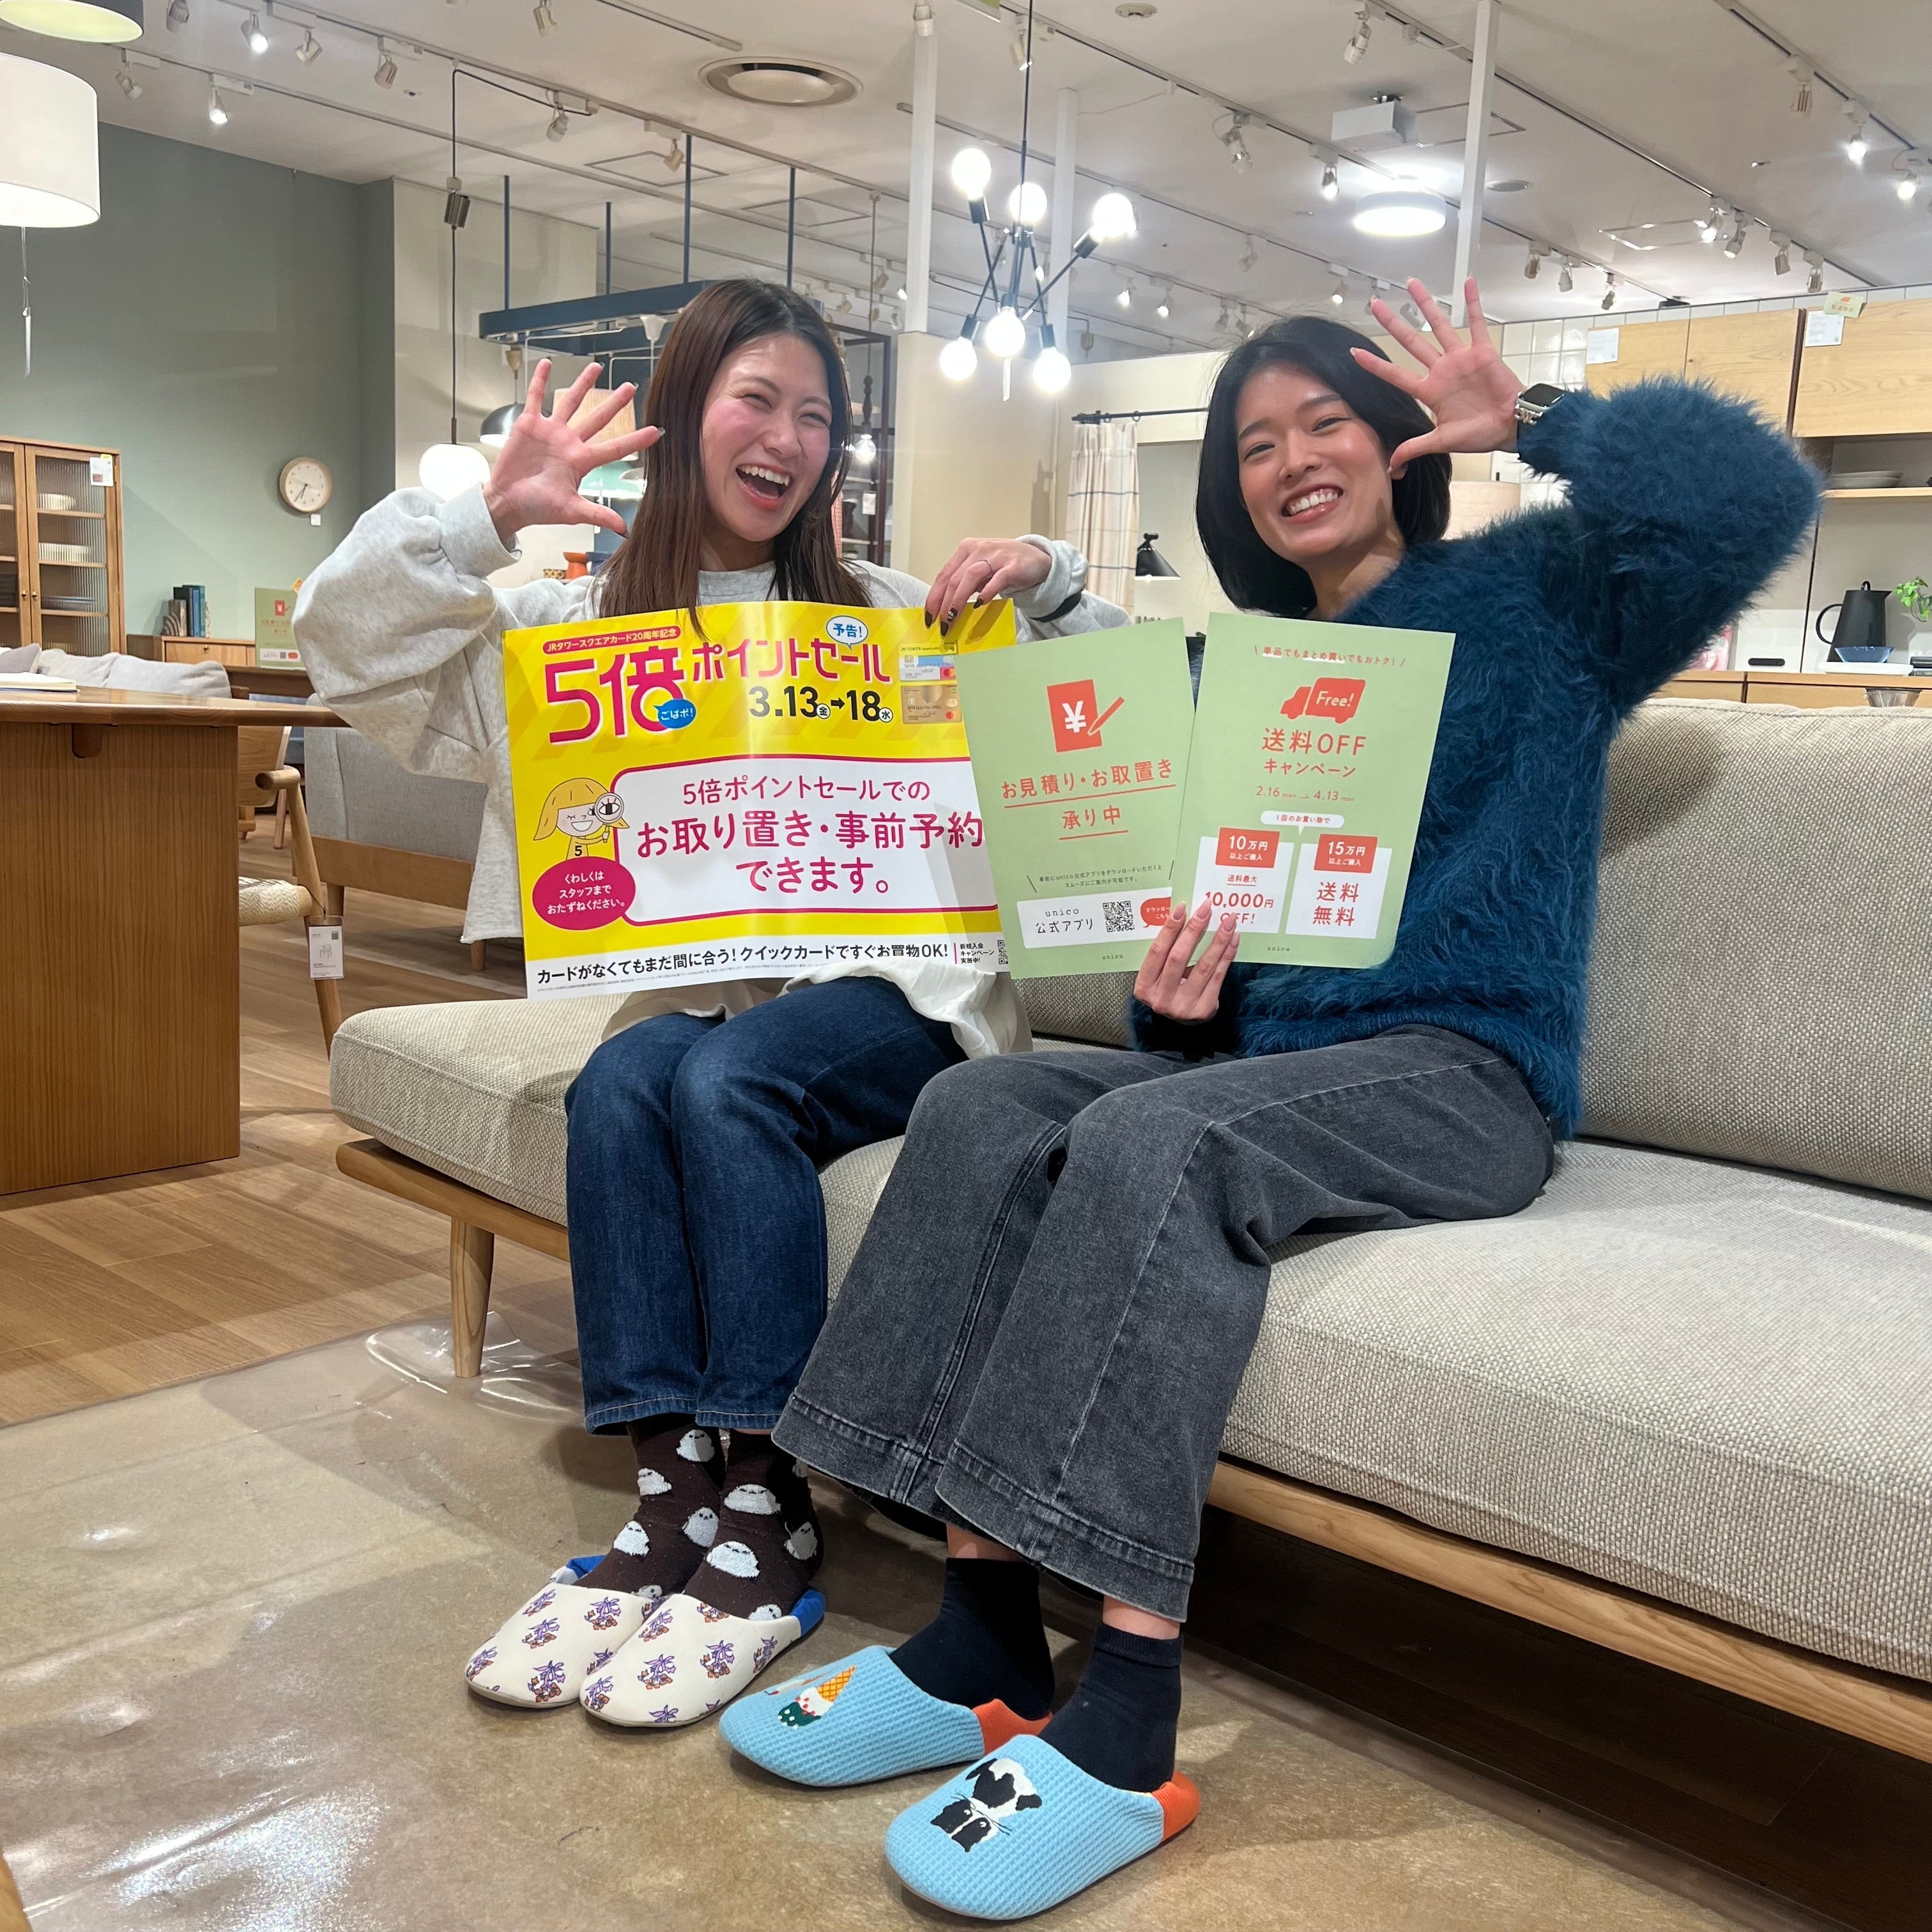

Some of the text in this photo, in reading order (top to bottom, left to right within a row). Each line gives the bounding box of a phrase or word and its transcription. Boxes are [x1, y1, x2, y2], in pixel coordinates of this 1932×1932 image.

[833, 623, 862, 638] 予告!
[546, 628, 678, 652] JRタワースクエアカード20周年記念
[692, 638, 891, 682] ポイントセール
[1315, 691, 1354, 707] Free!
[1261, 728, 1367, 755] 送料OFF
[1264, 758, 1356, 778] キャンペーン
[1002, 759, 1171, 799] お見積り・お取置き
[684, 775, 930, 805] 5倍ポイントセールでの
[1255, 786, 1280, 797] 2.16
[1314, 790, 1338, 801] 4.13
[1062, 805, 1121, 830] 承り中
[638, 809, 983, 858] お取り置き・事前予約
[575, 845, 582, 856] 5
[1229, 835, 1268, 851] 10万円
[1328, 841, 1365, 856] 15万円
[565, 871, 604, 884] くわしくは
[736, 856, 889, 894] できます。
[1227, 874, 1257, 884] 送料最大
[559, 885, 612, 900] スタッフまで
[1316, 882, 1359, 903] 送料
[547, 899, 625, 915] おたずねください。
[1045, 908, 1079, 917] unico
[1312, 906, 1355, 926] 無料
[1036, 918, 1093, 934] 公式アプリ
